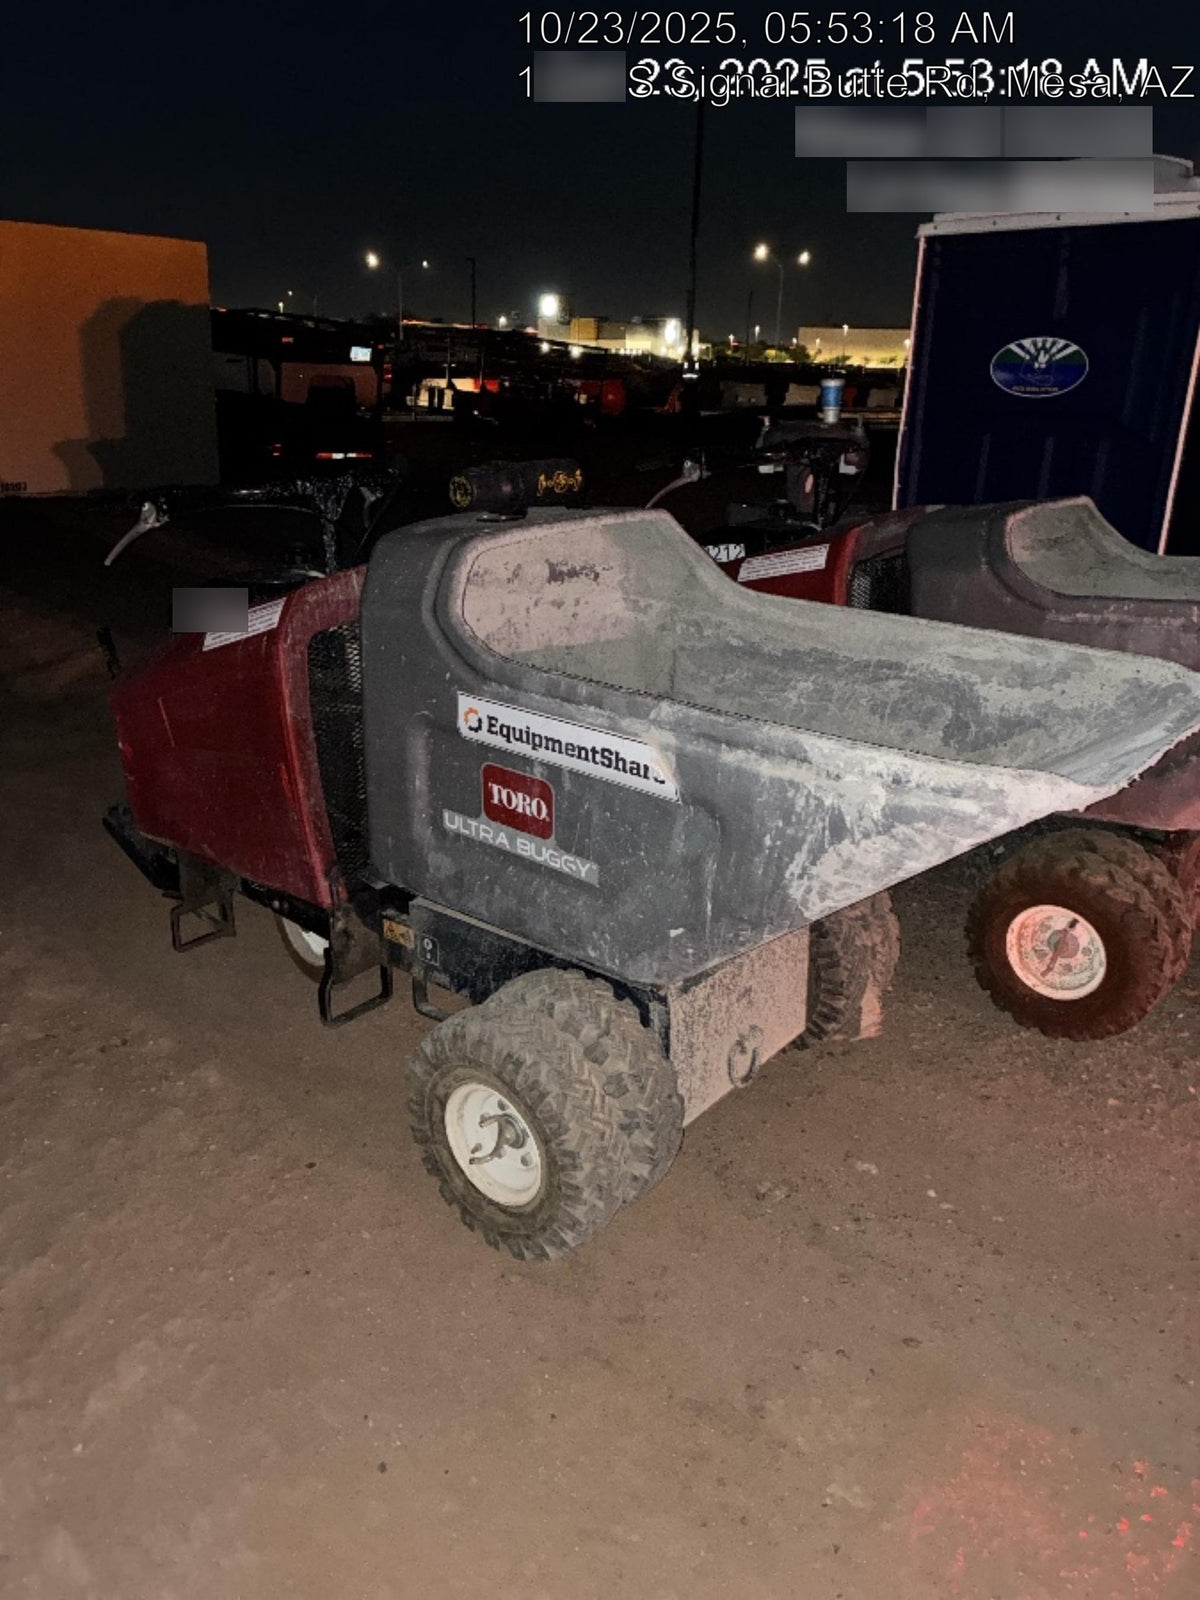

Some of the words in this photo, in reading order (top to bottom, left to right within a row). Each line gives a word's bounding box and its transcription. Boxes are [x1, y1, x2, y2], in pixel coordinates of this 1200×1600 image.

[488, 782, 549, 822] TORO
[443, 814, 511, 850] ULTRA
[516, 838, 592, 878] BUGGY
